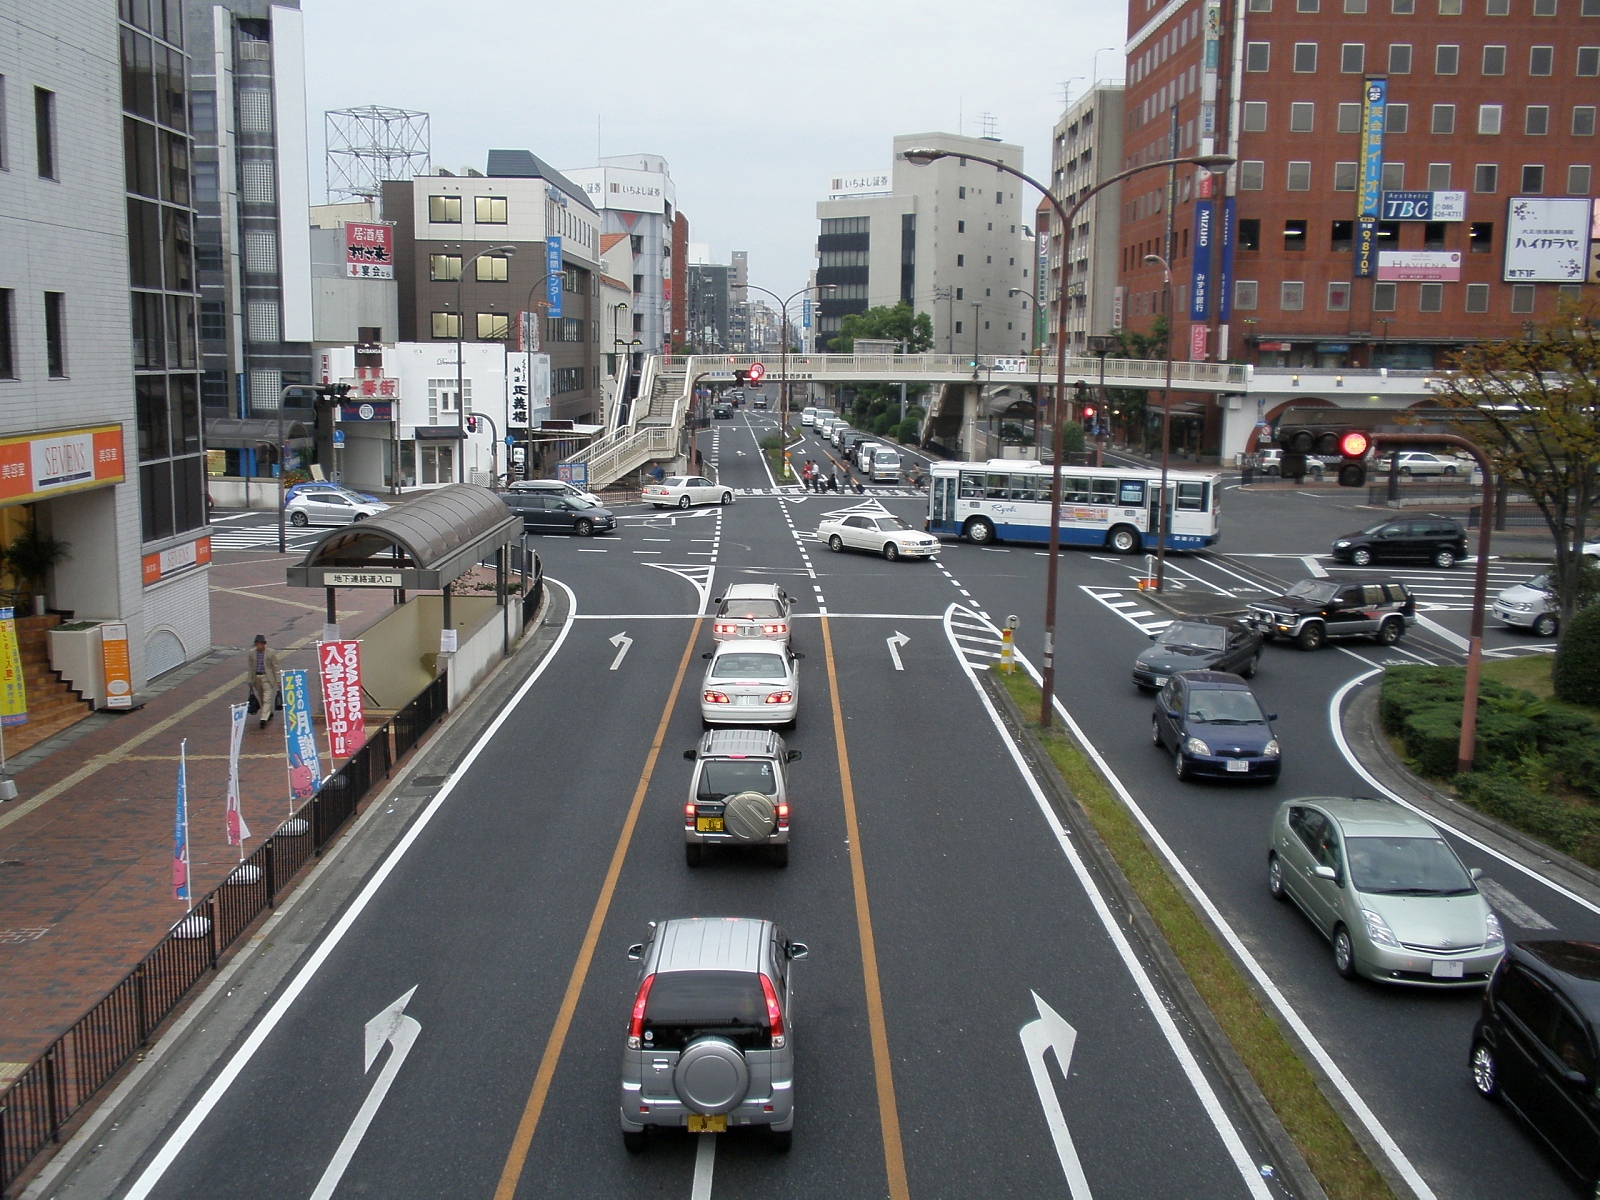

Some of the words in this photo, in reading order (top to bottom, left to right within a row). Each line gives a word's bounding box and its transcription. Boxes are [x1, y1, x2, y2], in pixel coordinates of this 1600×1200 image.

[622, 186, 660, 197] いちよし証券
[845, 176, 888, 188] いちよし証券
[1387, 200, 1429, 217] TBC
[353, 227, 385, 242] 居酒屋
[1200, 209, 1209, 247] MIZUHO
[348, 243, 391, 262] 村さ来
[1515, 238, 1578, 249] ハイカラヤ
[45, 443, 85, 475] SEVENS
[343, 643, 359, 685] NOVA
[284, 675, 298, 732] NOVA
[347, 685, 362, 721] KIDS
